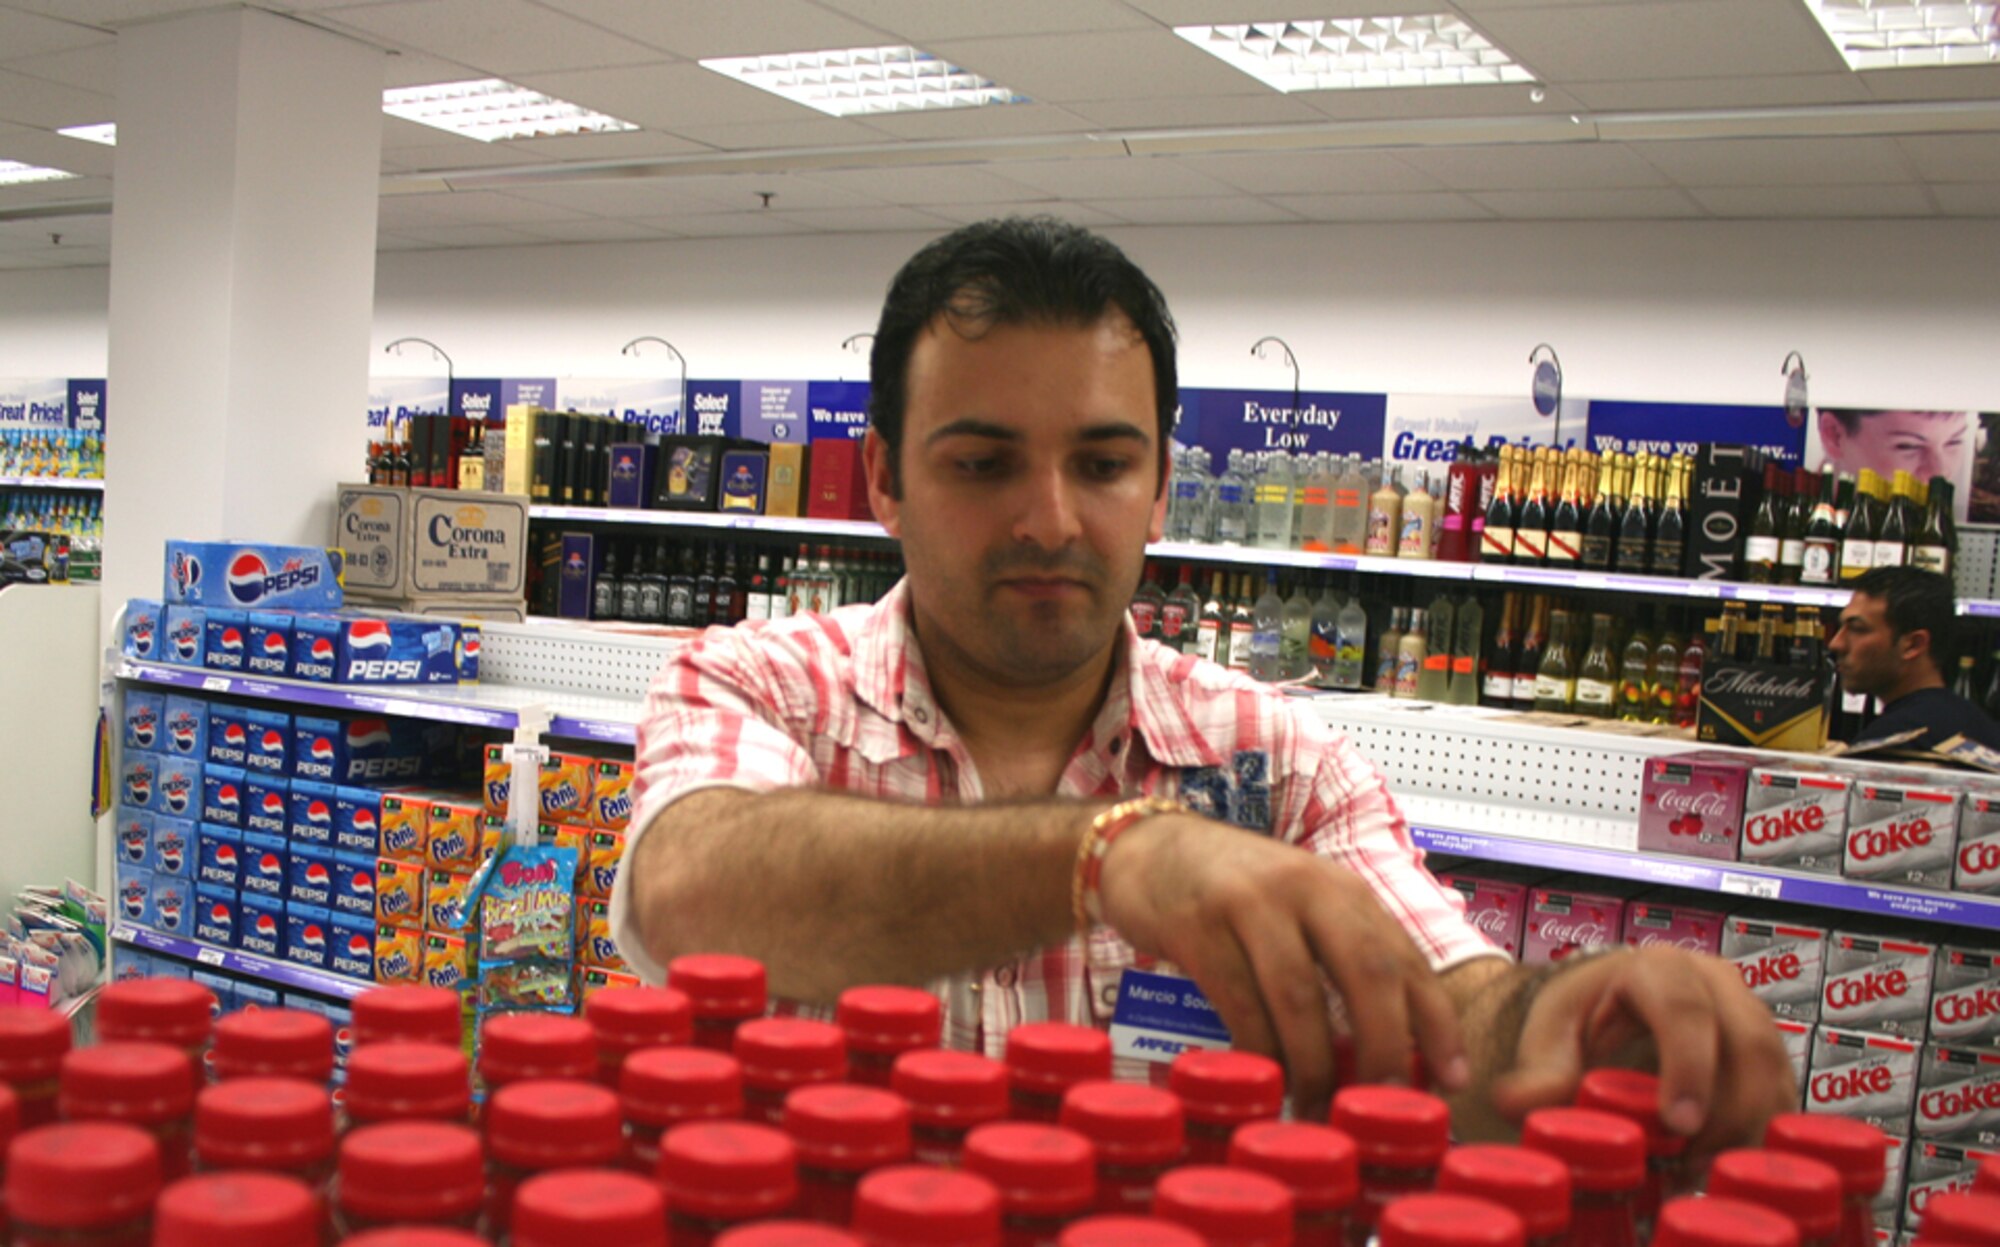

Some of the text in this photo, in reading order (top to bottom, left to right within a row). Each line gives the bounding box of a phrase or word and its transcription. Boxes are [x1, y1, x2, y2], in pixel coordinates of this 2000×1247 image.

[461, 393, 491, 411] Select
[694, 394, 728, 412] Select
[0, 402, 64, 422] reat Price!
[623, 409, 680, 433] Price!
[812, 409, 865, 423] We save
[1243, 401, 1341, 431] Everyday
[1265, 427, 1310, 448] Low
[1594, 435, 1621, 451] We
[1626, 439, 1672, 453] save
[1676, 443, 1698, 456] yo
[1699, 441, 1745, 581] MOËT
[347, 513, 391, 534] Corona
[428, 514, 505, 547] Corona
[449, 546, 488, 559] Extra
[263, 565, 319, 595] PEPSI
[206, 652, 242, 667] PEPSI
[250, 656, 285, 672] PEPSI
[296, 662, 332, 679] PEPSI
[347, 660, 422, 680] PEPSI
[1704, 667, 1815, 697] Michelob
[211, 746, 244, 762] PEPSI
[248, 753, 282, 770] PEPSI
[297, 761, 332, 778] PEPSI
[347, 756, 422, 778] PEPSI
[205, 806, 238, 822] PEPSI
[249, 815, 283, 832] PEPSI
[292, 824, 329, 840] PEPSI
[1746, 805, 1824, 846] Coke
[337, 832, 375, 849] PEPSI
[1848, 818, 1932, 861] Coke
[1959, 841, 2000, 875] Co
[201, 866, 235, 882] PEPSI
[245, 875, 280, 892] PEPSI
[291, 885, 328, 902] PEPSI
[1867, 890, 1881, 899] We
[1883, 892, 1904, 901] save
[1905, 895, 1922, 905] you
[336, 894, 373, 912] PEPSI
[1890, 901, 1938, 914] everyday!
[198, 925, 230, 941] PEPSI
[242, 935, 276, 953] PEPSI
[289, 945, 324, 963] PEPSI
[334, 957, 370, 975] PEPSI
[1735, 953, 1799, 988] oke
[1825, 969, 1907, 1009] Coke
[1128, 985, 1216, 1012] Marcio Sou
[1934, 988, 2000, 1024] Cok
[1810, 1066, 1892, 1103] Coke
[1919, 1082, 2000, 1120] Coke
